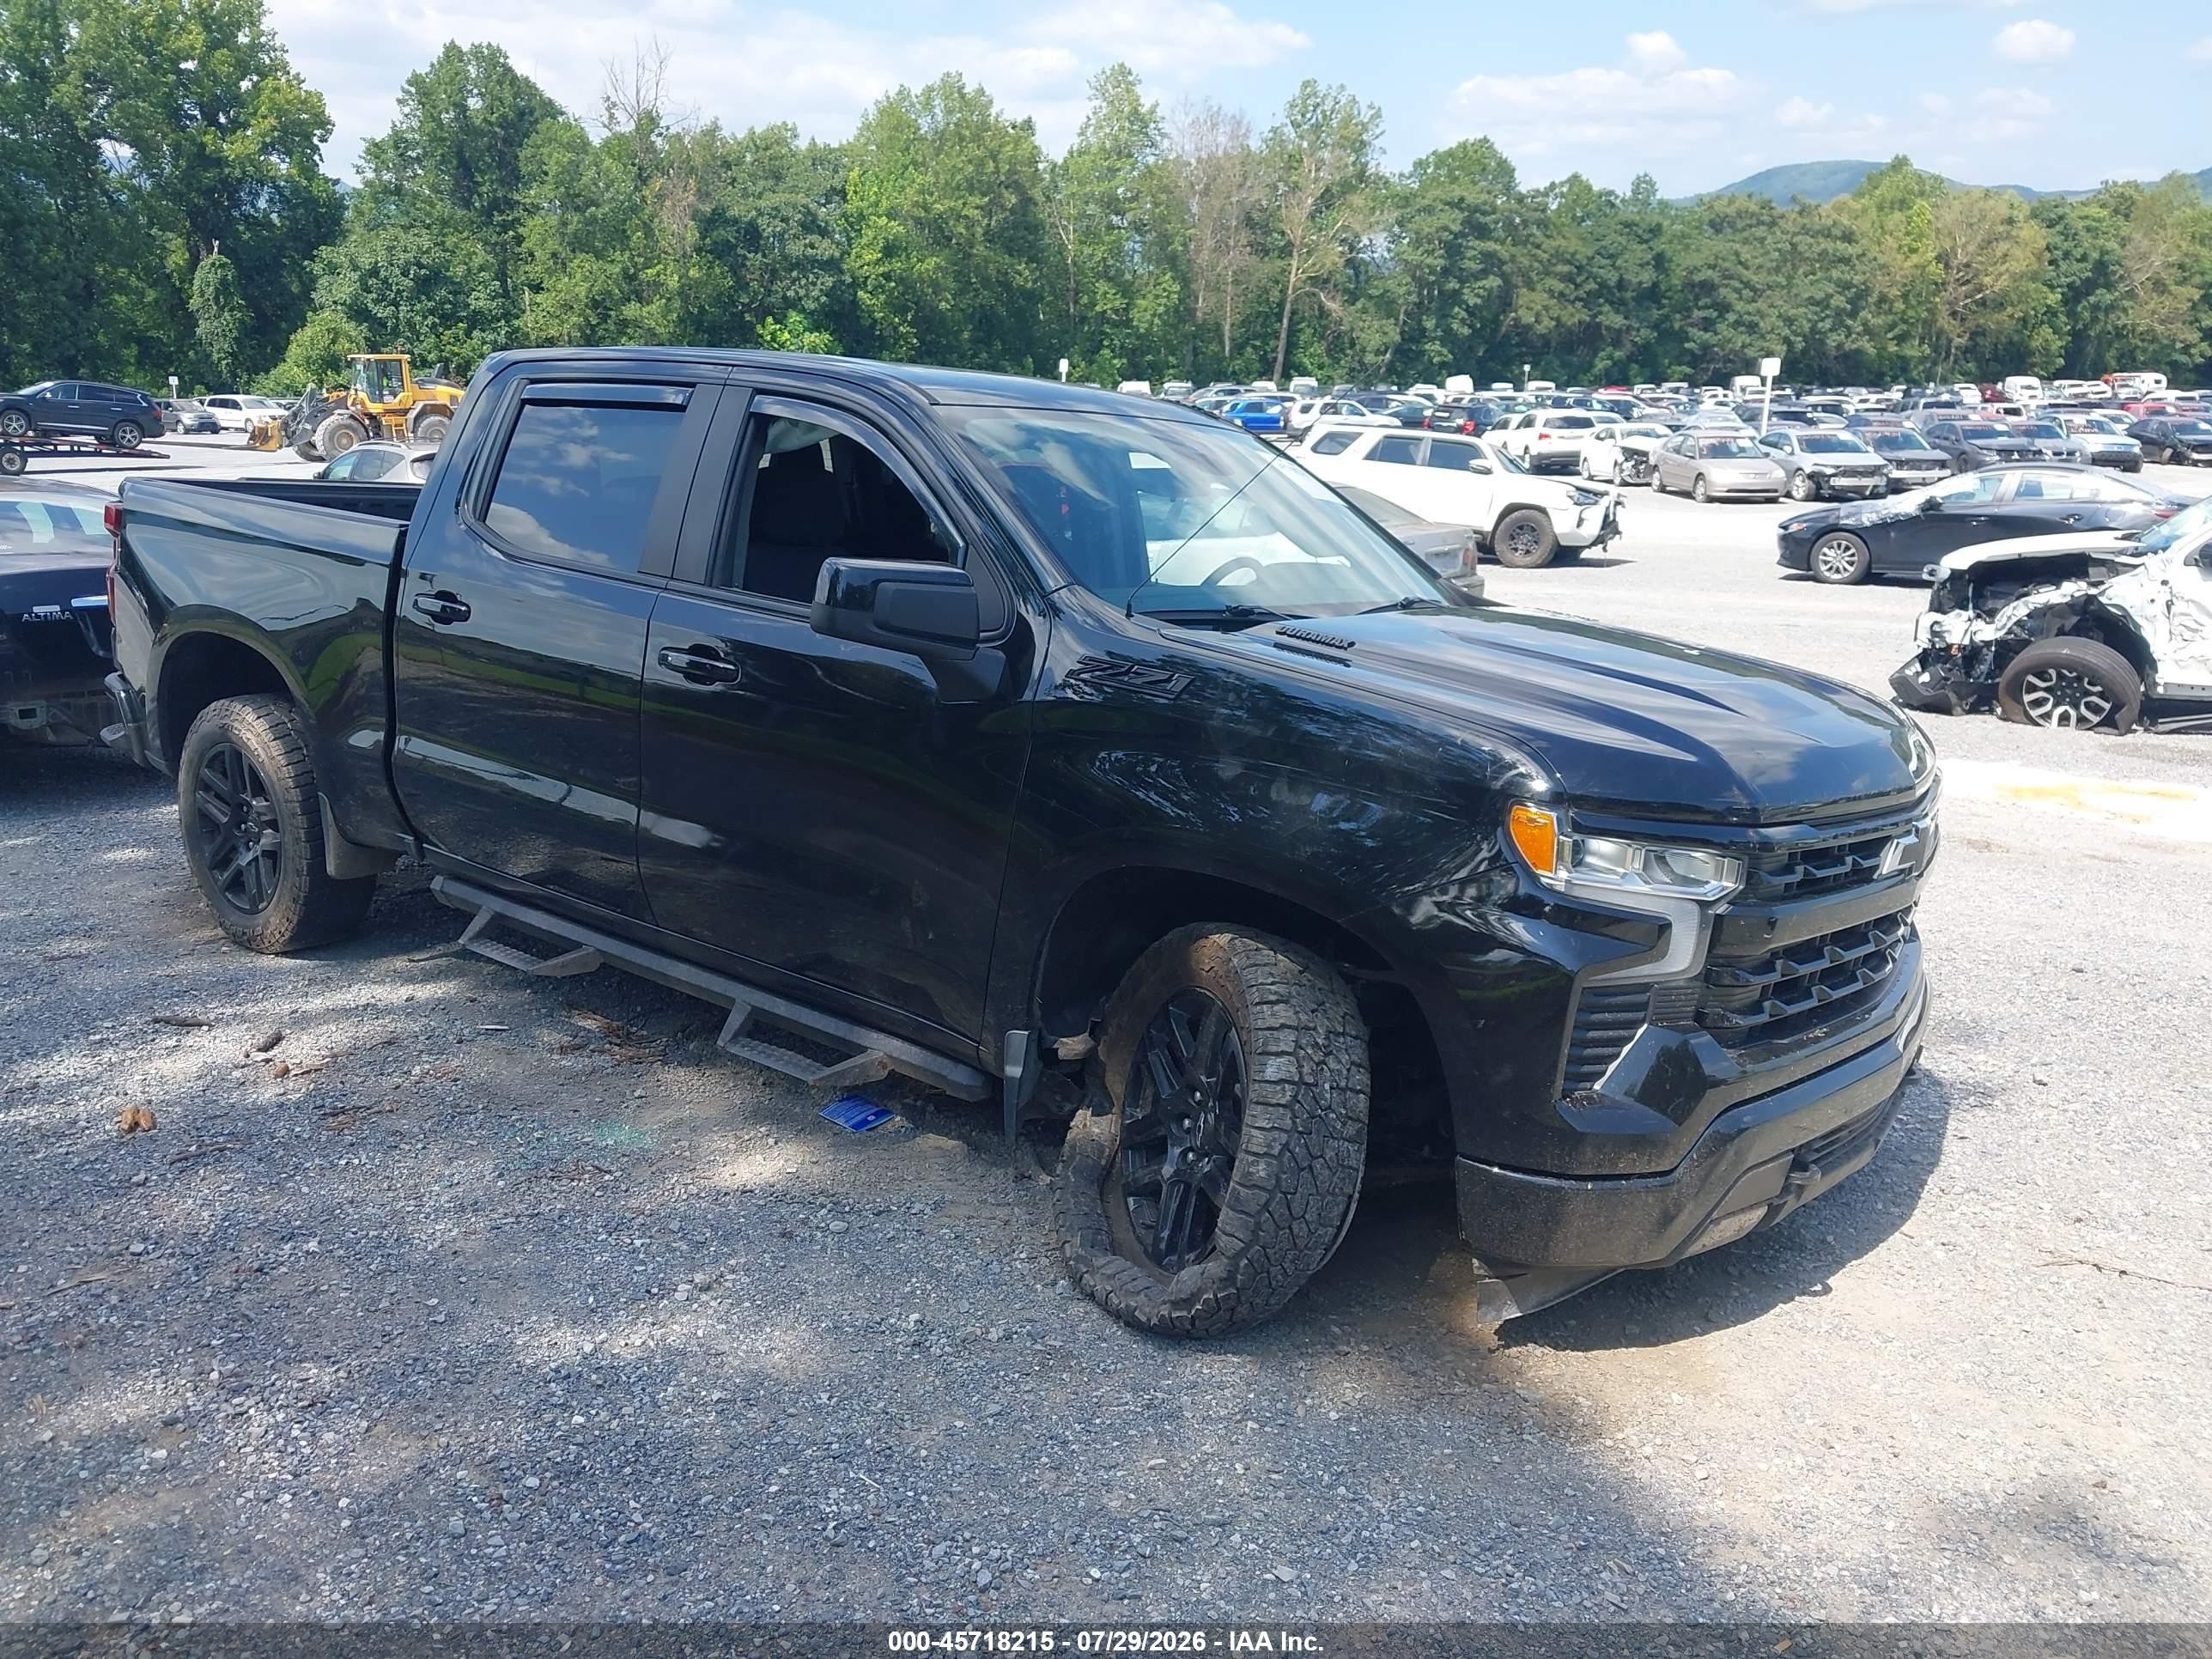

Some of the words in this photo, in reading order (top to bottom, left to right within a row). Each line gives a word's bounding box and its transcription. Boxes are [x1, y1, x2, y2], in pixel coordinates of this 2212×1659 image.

[21, 611, 74, 622] ALTIMA
[1275, 626, 1356, 651] DURAMAX
[1065, 655, 1196, 700] Z71
